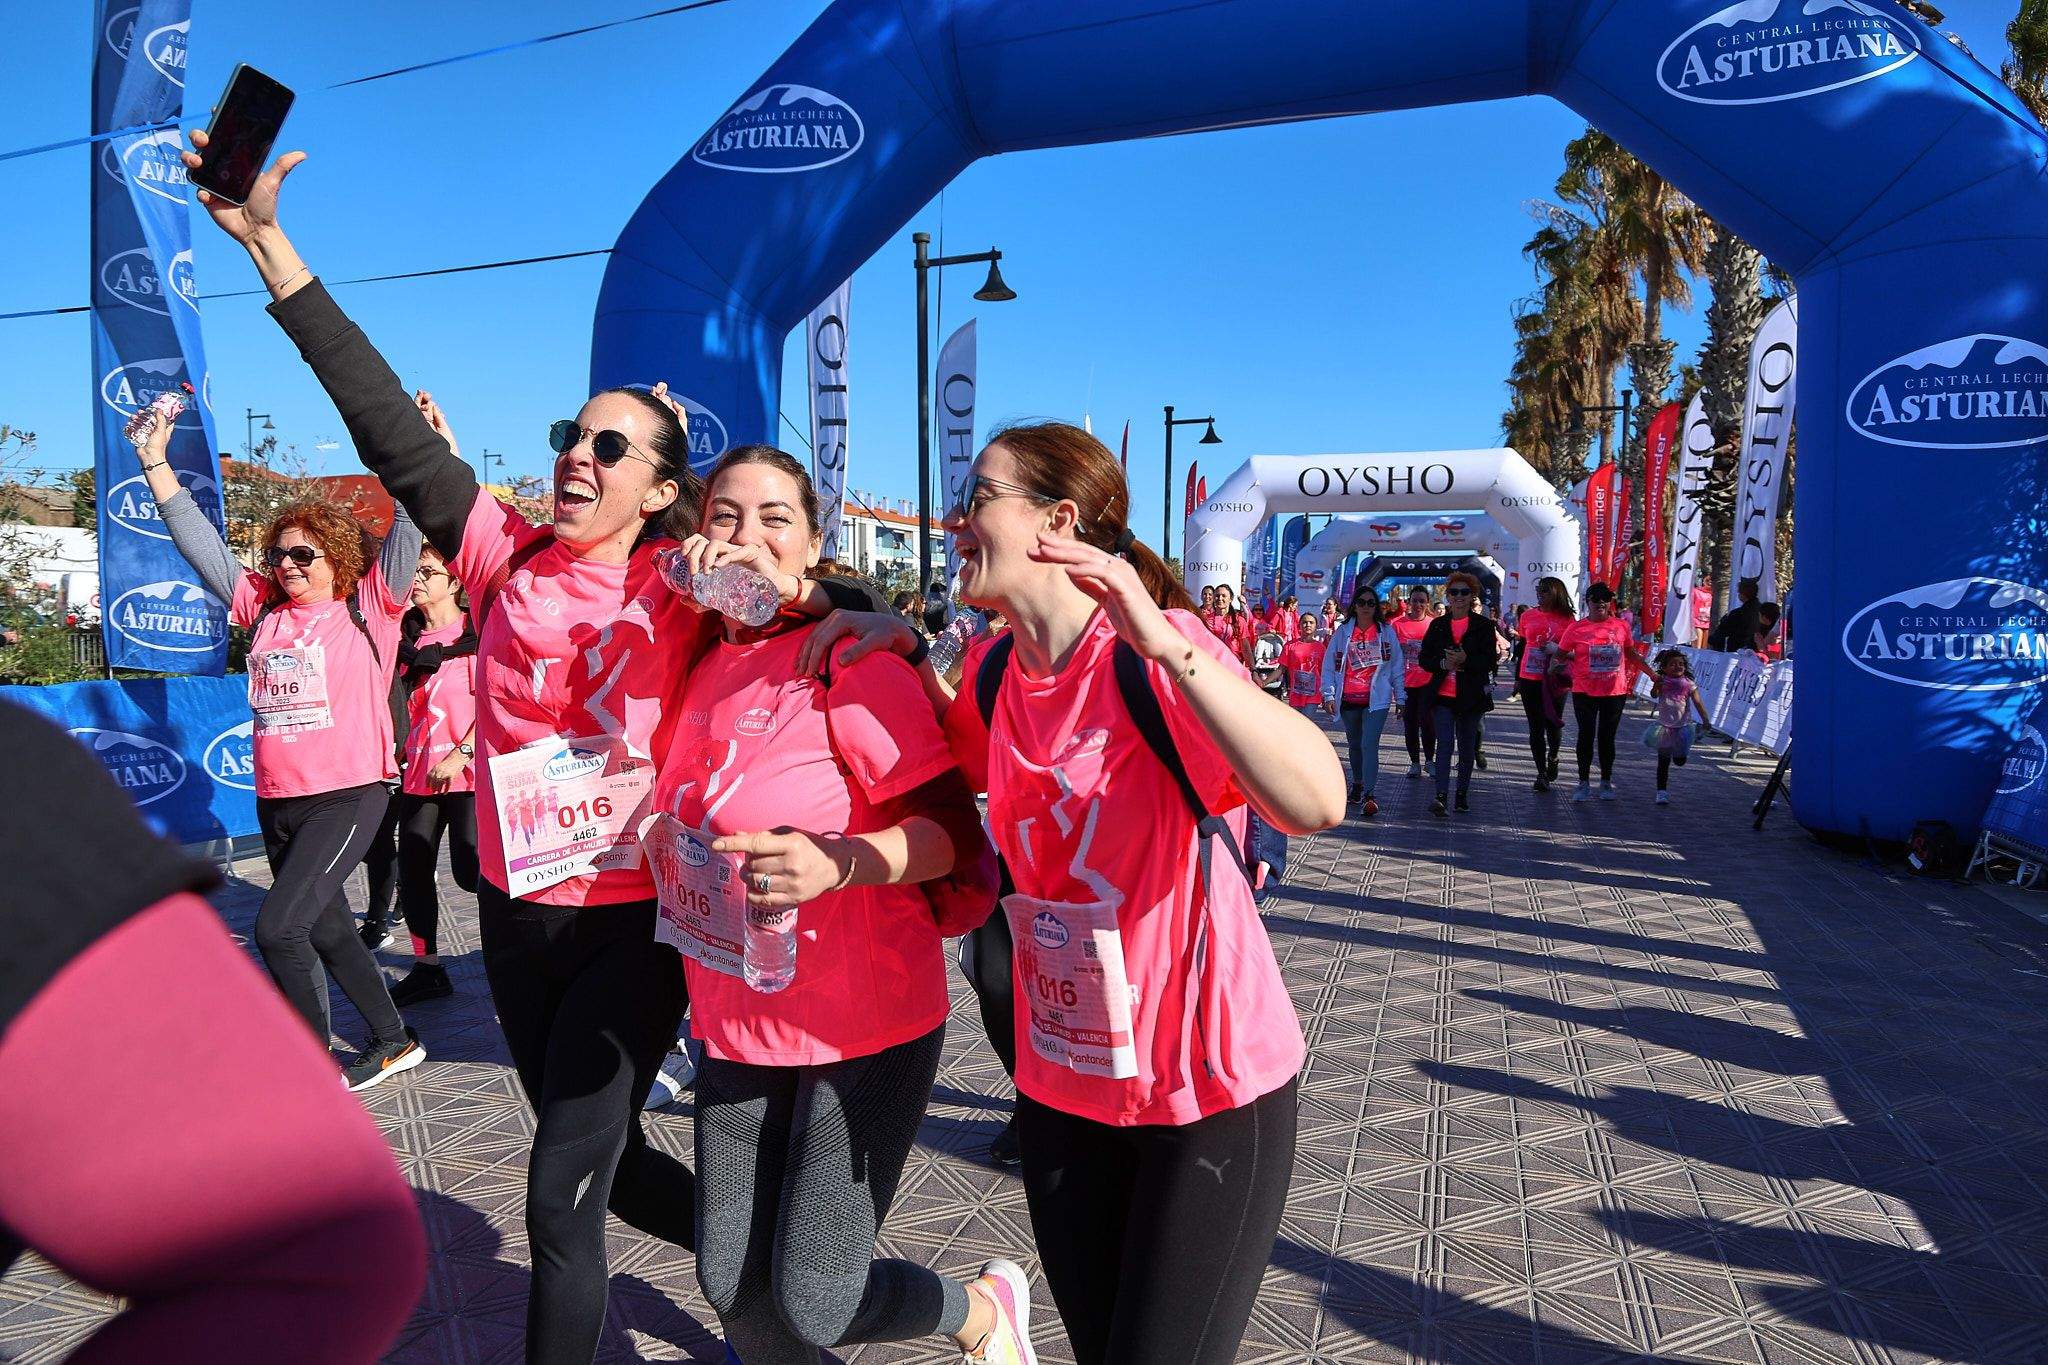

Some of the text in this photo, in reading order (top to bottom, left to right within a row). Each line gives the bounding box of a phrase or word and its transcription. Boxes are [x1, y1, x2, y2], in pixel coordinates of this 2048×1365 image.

[1717, 19, 1892, 48] CENTRAL LECHERA
[1677, 32, 1907, 89] ASTURIANA
[727, 110, 843, 128] CENTRAL LECHERA
[699, 124, 850, 156] ASTURIANA
[139, 377, 181, 388] CENTR
[1904, 372, 2048, 390] CENTRAL LECH
[1863, 384, 2048, 427] ASTURIA
[943, 373, 974, 498] SHO
[1740, 341, 1794, 585] OYSHO
[1298, 463, 1455, 498] OYSHO
[1210, 502, 1253, 513] OYSHO
[1502, 496, 1551, 507] OYSHO
[1648, 432, 1667, 619] Sports Santander
[1188, 561, 1228, 572] OYSHO
[1392, 562, 1459, 570] VOLVO
[1528, 562, 1575, 573] OYSHO
[141, 602, 181, 613] CENTRAL
[121, 602, 222, 638] ASTURIANA
[1900, 616, 2047, 628] CENTRAL LECHE
[1859, 618, 2048, 661] ASTURIAN
[271, 681, 299, 696] 016
[547, 758, 601, 778] ASTURIANA
[557, 796, 613, 829] 016
[572, 827, 598, 842] 4462
[526, 852, 561, 865] CARRERA
[562, 848, 572, 856] DE
[611, 835, 638, 844] VALENC
[526, 861, 574, 883] OYSHO
[677, 883, 712, 917] 016
[706, 951, 740, 969] Santander
[1038, 974, 1078, 1007] 016
[1077, 1032, 1109, 1044] VALENCIA
[1071, 1052, 1114, 1068] Santander
